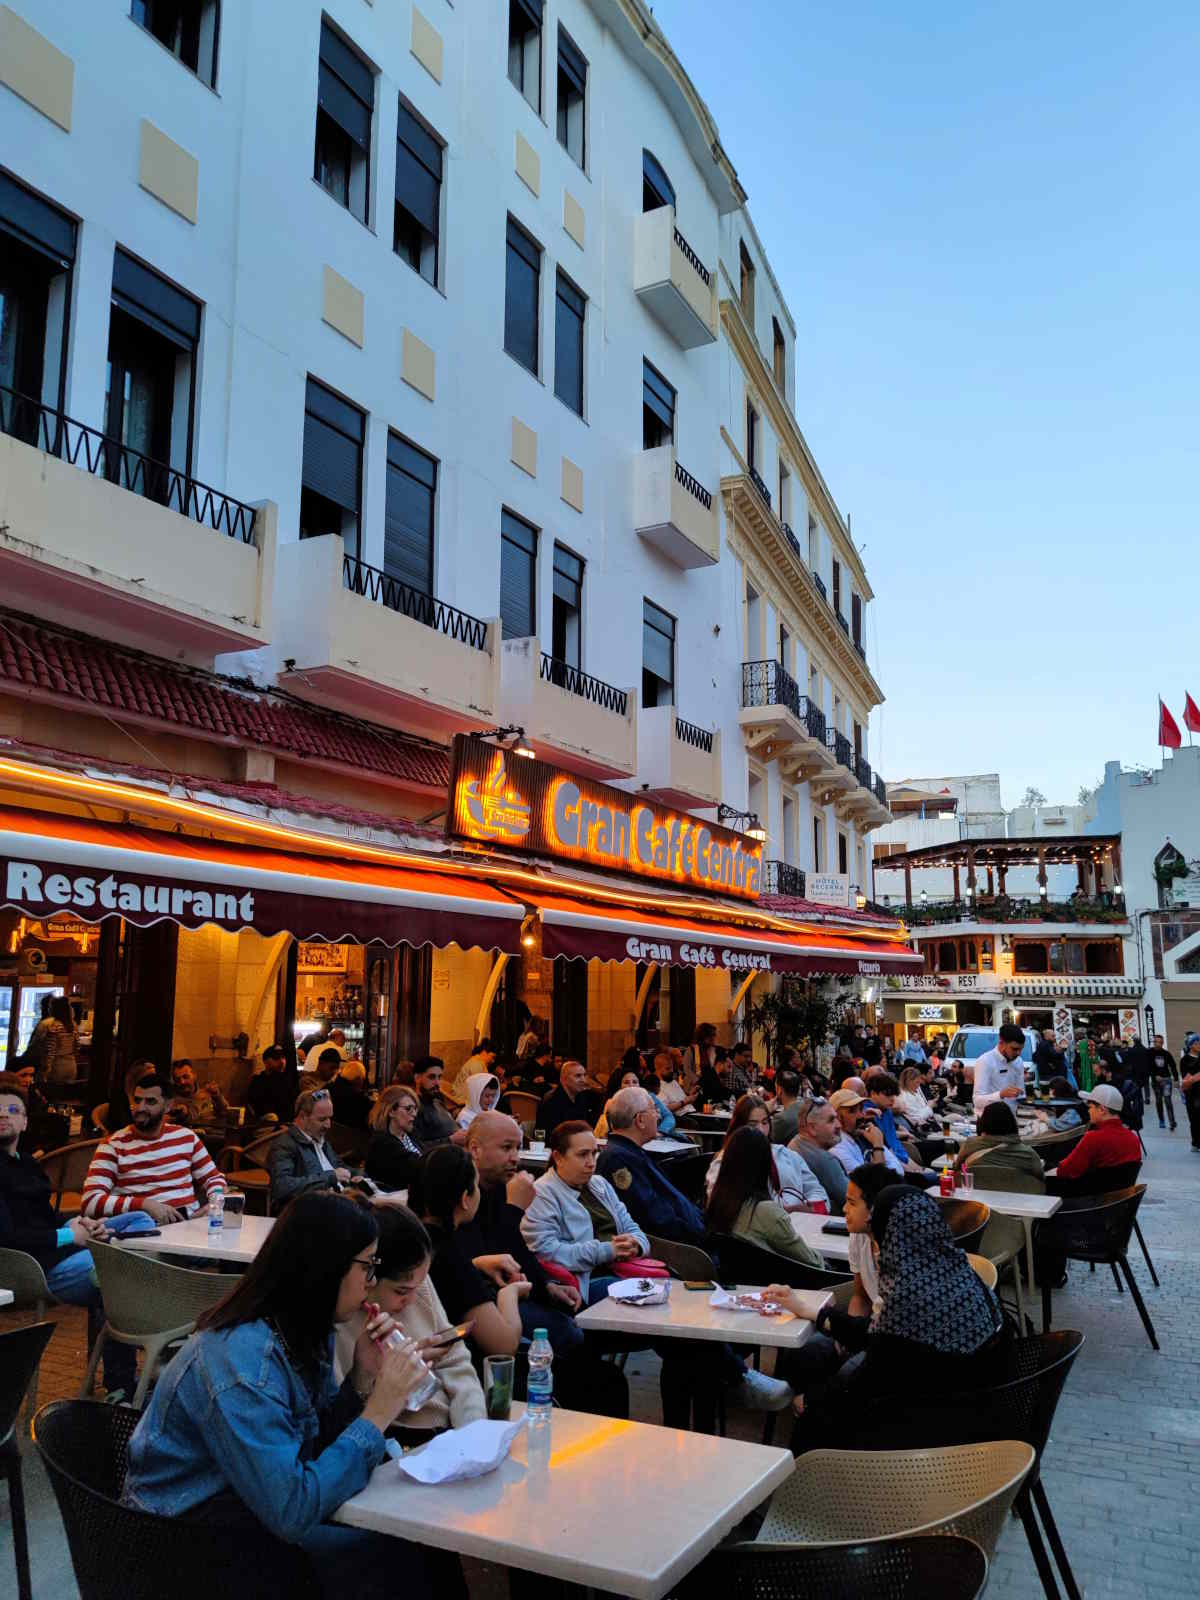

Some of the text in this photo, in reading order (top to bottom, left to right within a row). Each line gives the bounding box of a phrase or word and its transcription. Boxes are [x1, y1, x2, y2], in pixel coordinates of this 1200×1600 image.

[554, 782, 766, 894] Gran Café Central
[6, 860, 255, 922] Restaurant
[625, 937, 772, 970] Gran Café Central
[858, 960, 880, 973] Pizzeria
[902, 975, 977, 987] LE BISTRO REST
